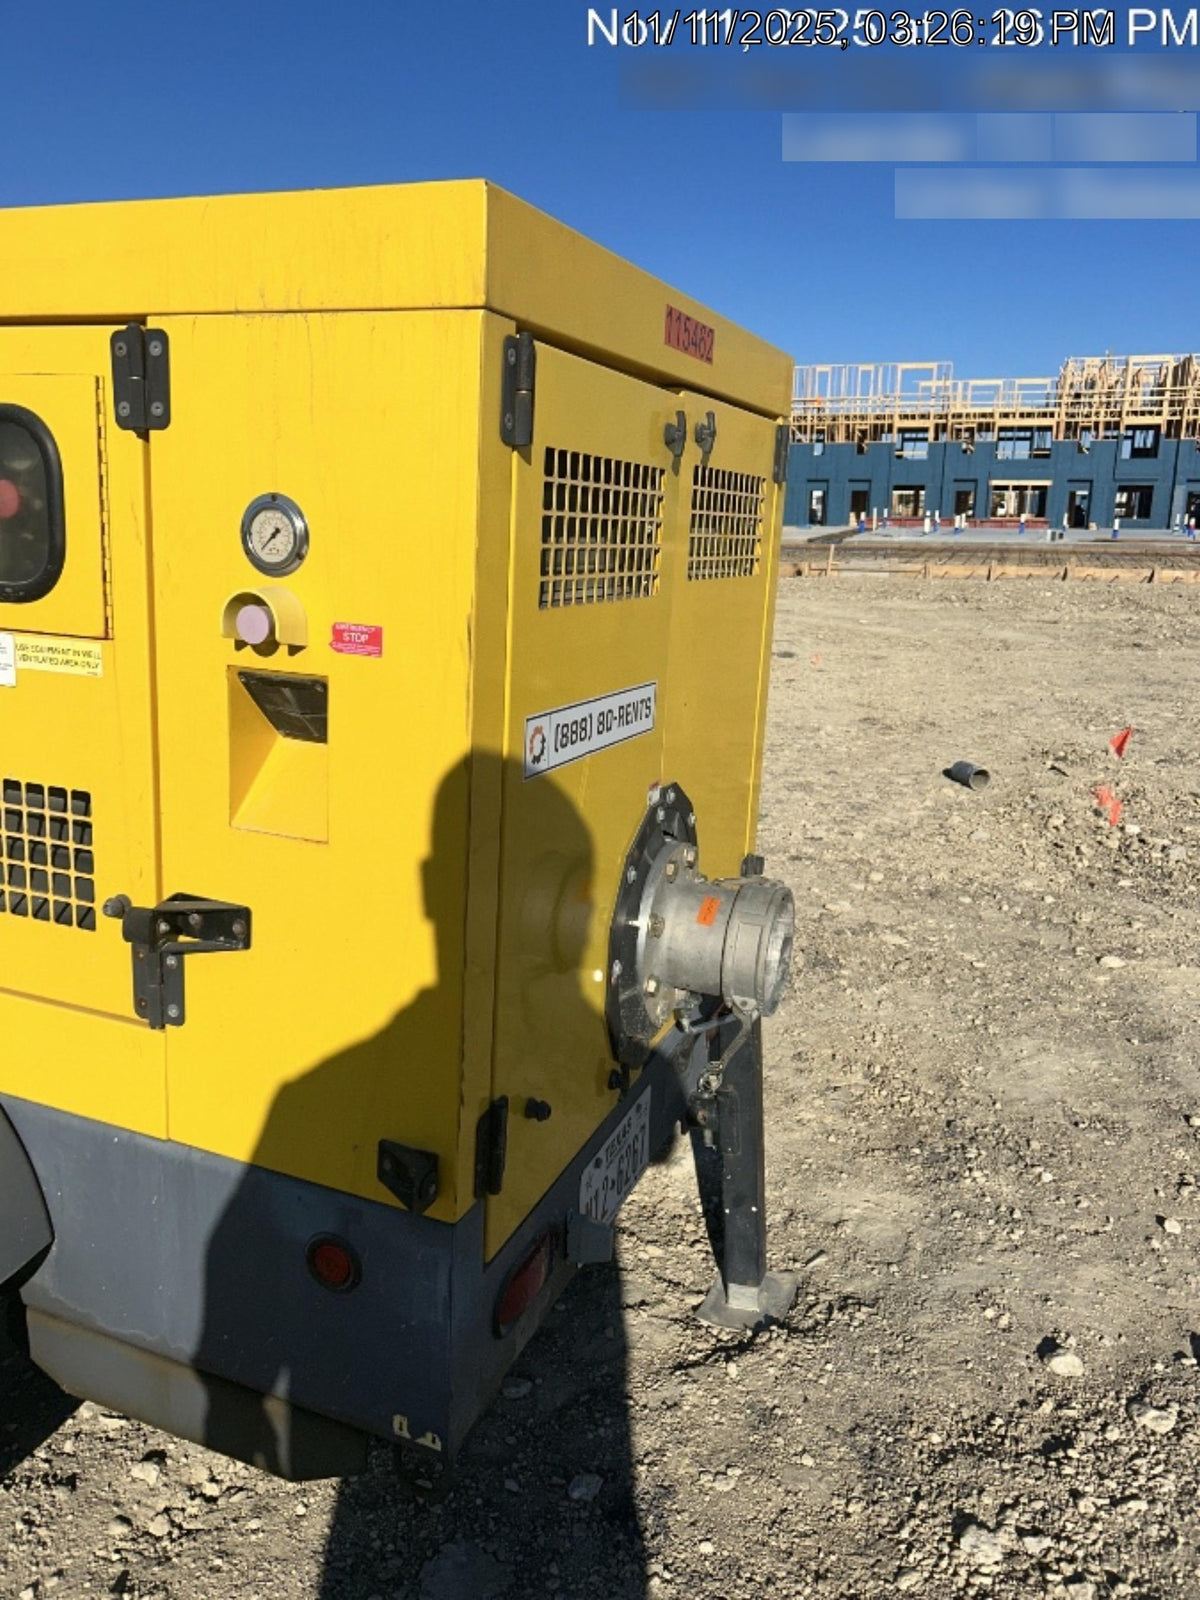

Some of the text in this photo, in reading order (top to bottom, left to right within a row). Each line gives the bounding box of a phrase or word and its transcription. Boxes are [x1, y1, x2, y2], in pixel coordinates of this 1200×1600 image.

[665, 305, 714, 364] 115482
[342, 632, 368, 644] STOP
[554, 697, 652, 752] (888) 80-RENTS
